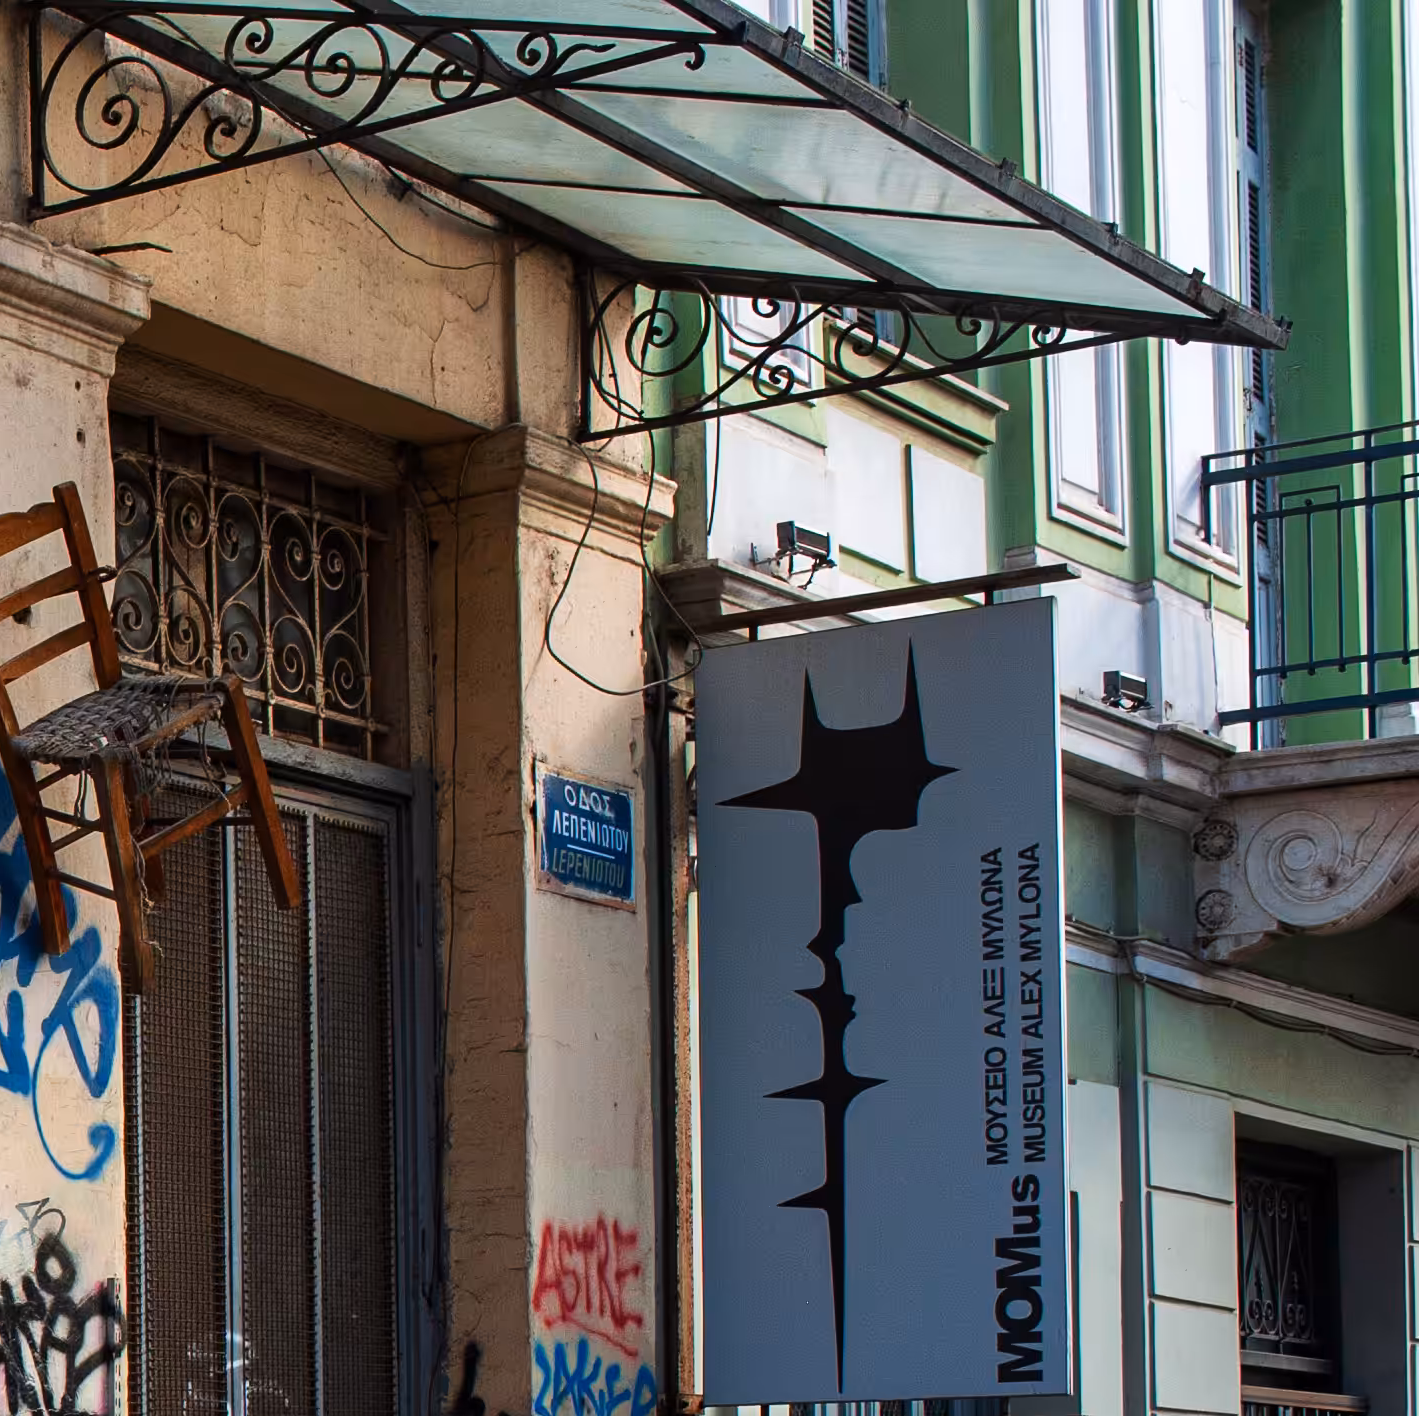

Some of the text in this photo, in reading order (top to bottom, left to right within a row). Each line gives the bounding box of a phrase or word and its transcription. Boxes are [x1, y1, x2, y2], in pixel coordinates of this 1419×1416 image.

[552, 809, 630, 854] ΛΕΠΕΝΙΩΤΟΥ
[564, 784, 611, 815] ΟΔΟΣ
[551, 847, 626, 889] LEPENIOTOU
[980, 846, 1009, 1166] ΜΟΥΣΕΙΟ ΑΛΕΞ ΜΥΛΩΝΑ
[1017, 842, 1046, 1164] MUSEUM ALEX MYLONA
[994, 1173, 1045, 1384] MOMus
